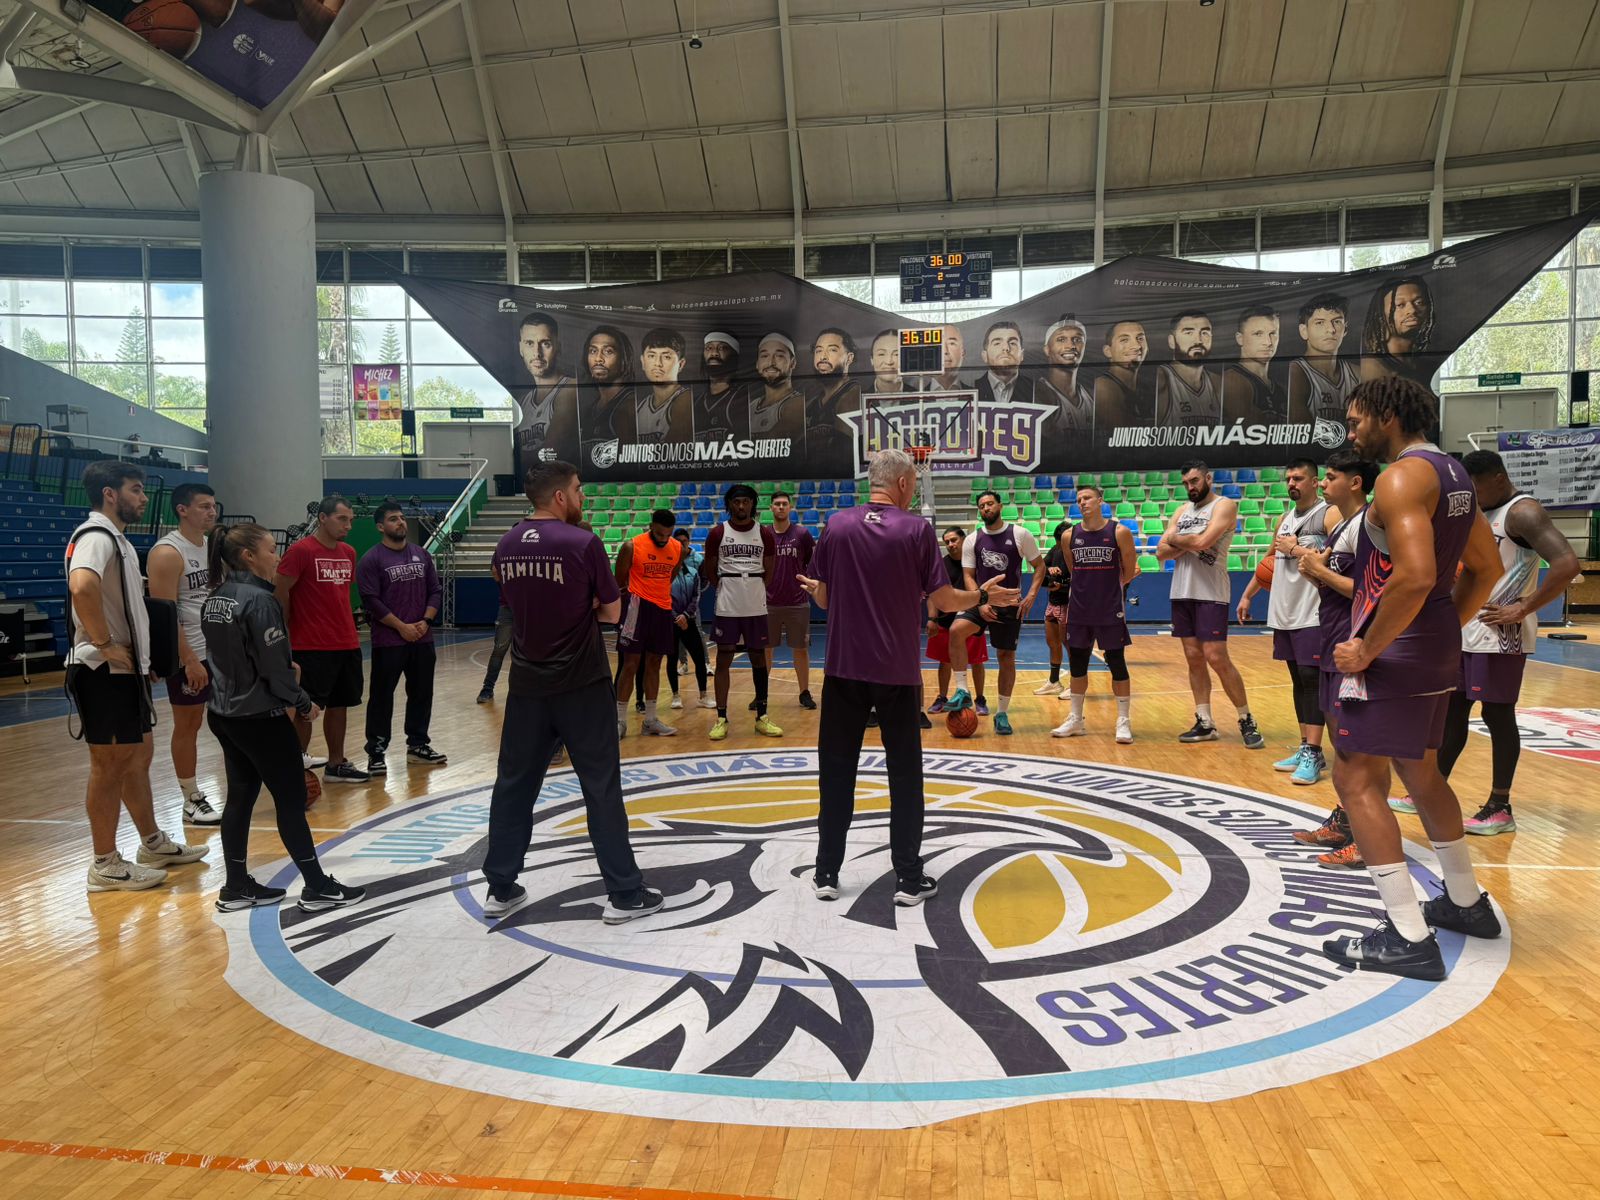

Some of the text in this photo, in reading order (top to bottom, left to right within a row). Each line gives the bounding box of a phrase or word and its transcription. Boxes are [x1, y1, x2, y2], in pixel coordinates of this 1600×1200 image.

[930, 253, 962, 267] 36:00
[937, 272, 944, 281] 2
[902, 330, 941, 345] 36:00
[500, 562, 564, 584] FAMILIA
[665, 754, 809, 778] MÁS
[1024, 770, 1226, 808] JUNTOS
[351, 803, 491, 864] JUNTOS
[1035, 931, 1357, 1047] FUERTES
